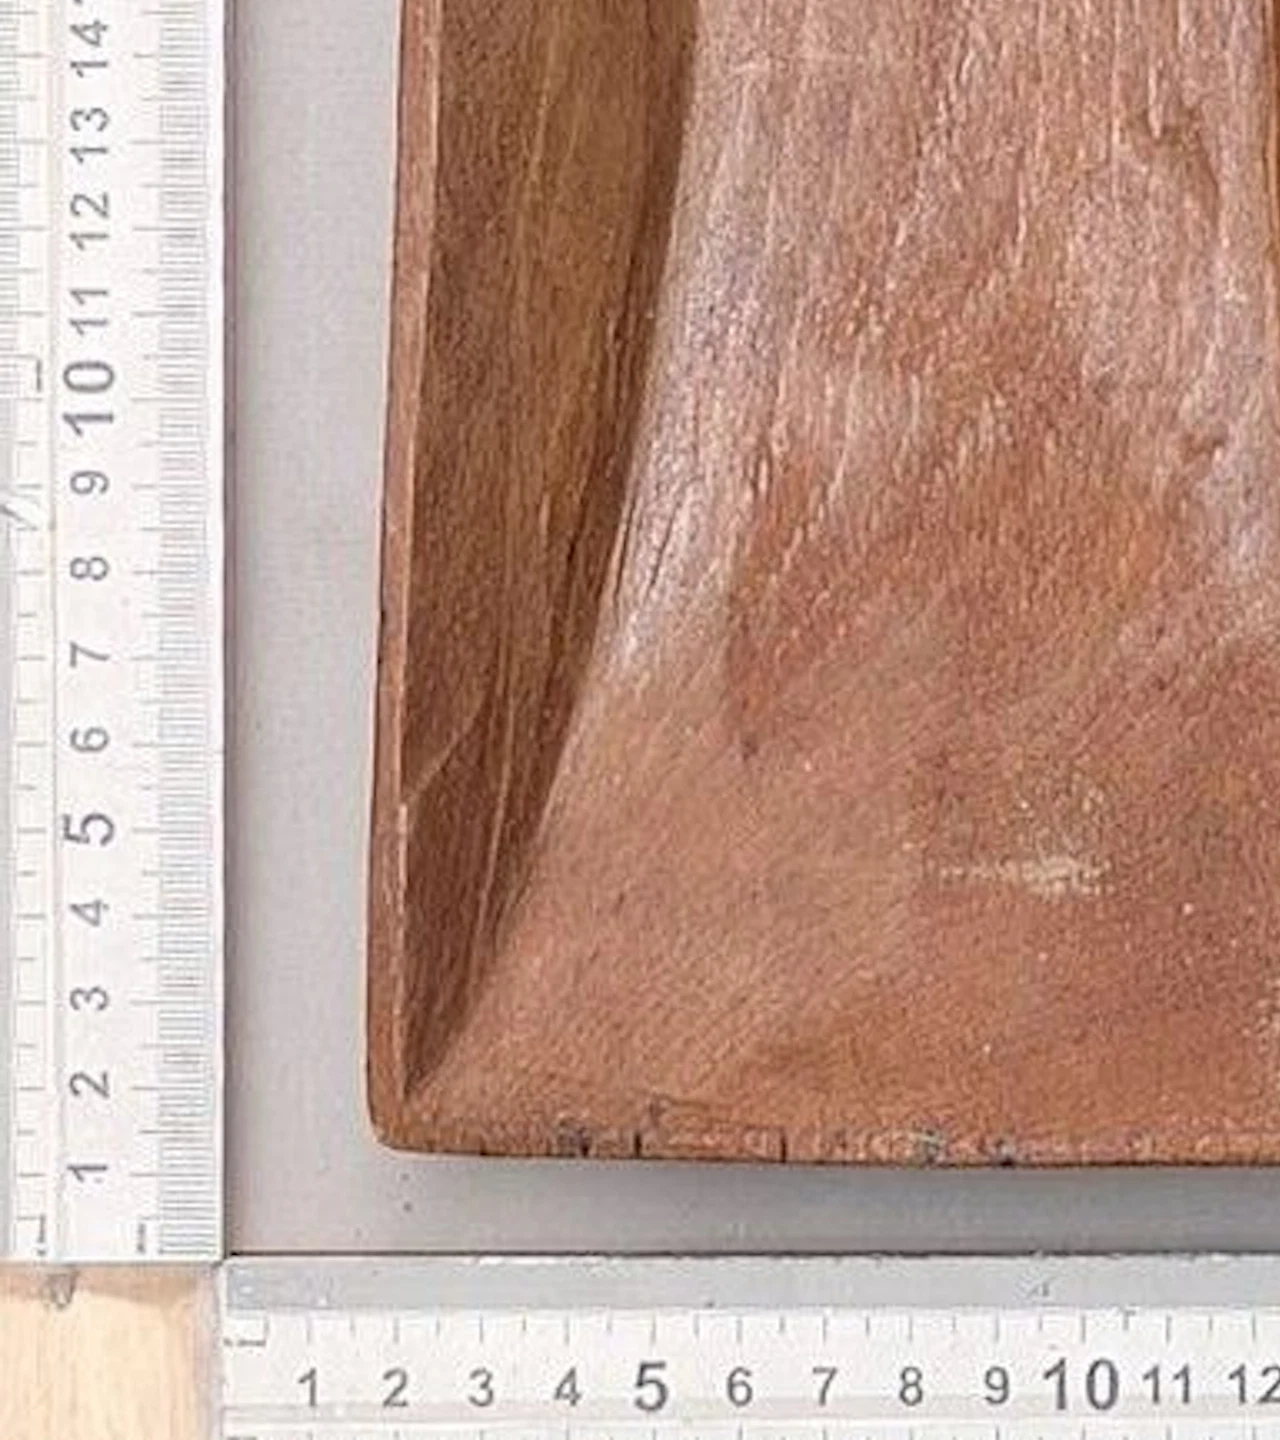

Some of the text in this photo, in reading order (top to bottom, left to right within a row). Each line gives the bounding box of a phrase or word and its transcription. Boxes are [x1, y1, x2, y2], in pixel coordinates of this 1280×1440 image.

[70, 20, 109, 78] 14
[70, 108, 110, 164] 13
[69, 192, 109, 250] 12
[70, 289, 109, 335] 11
[63, 361, 115, 436] 10
[70, 471, 109, 495] 9
[70, 556, 110, 581] 8
[70, 642, 110, 668] 7
[70, 727, 109, 753] 6
[62, 813, 115, 846] 5
[69, 900, 109, 926] 4
[69, 986, 109, 1011] 3
[68, 1072, 109, 1098] 2
[66, 1164, 108, 1182] 1
[298, 1368, 317, 1408] 1
[382, 1368, 409, 1408] 2
[469, 1368, 494, 1407] 3
[554, 1367, 582, 1407] 4
[634, 1361, 668, 1411] 5
[727, 1366, 753, 1408] 6
[812, 1366, 838, 1406] 7
[899, 1366, 923, 1406] 8
[984, 1366, 1009, 1405] 9
[1043, 1357, 1119, 1411] 10
[1143, 1364, 1190, 1405] 11
